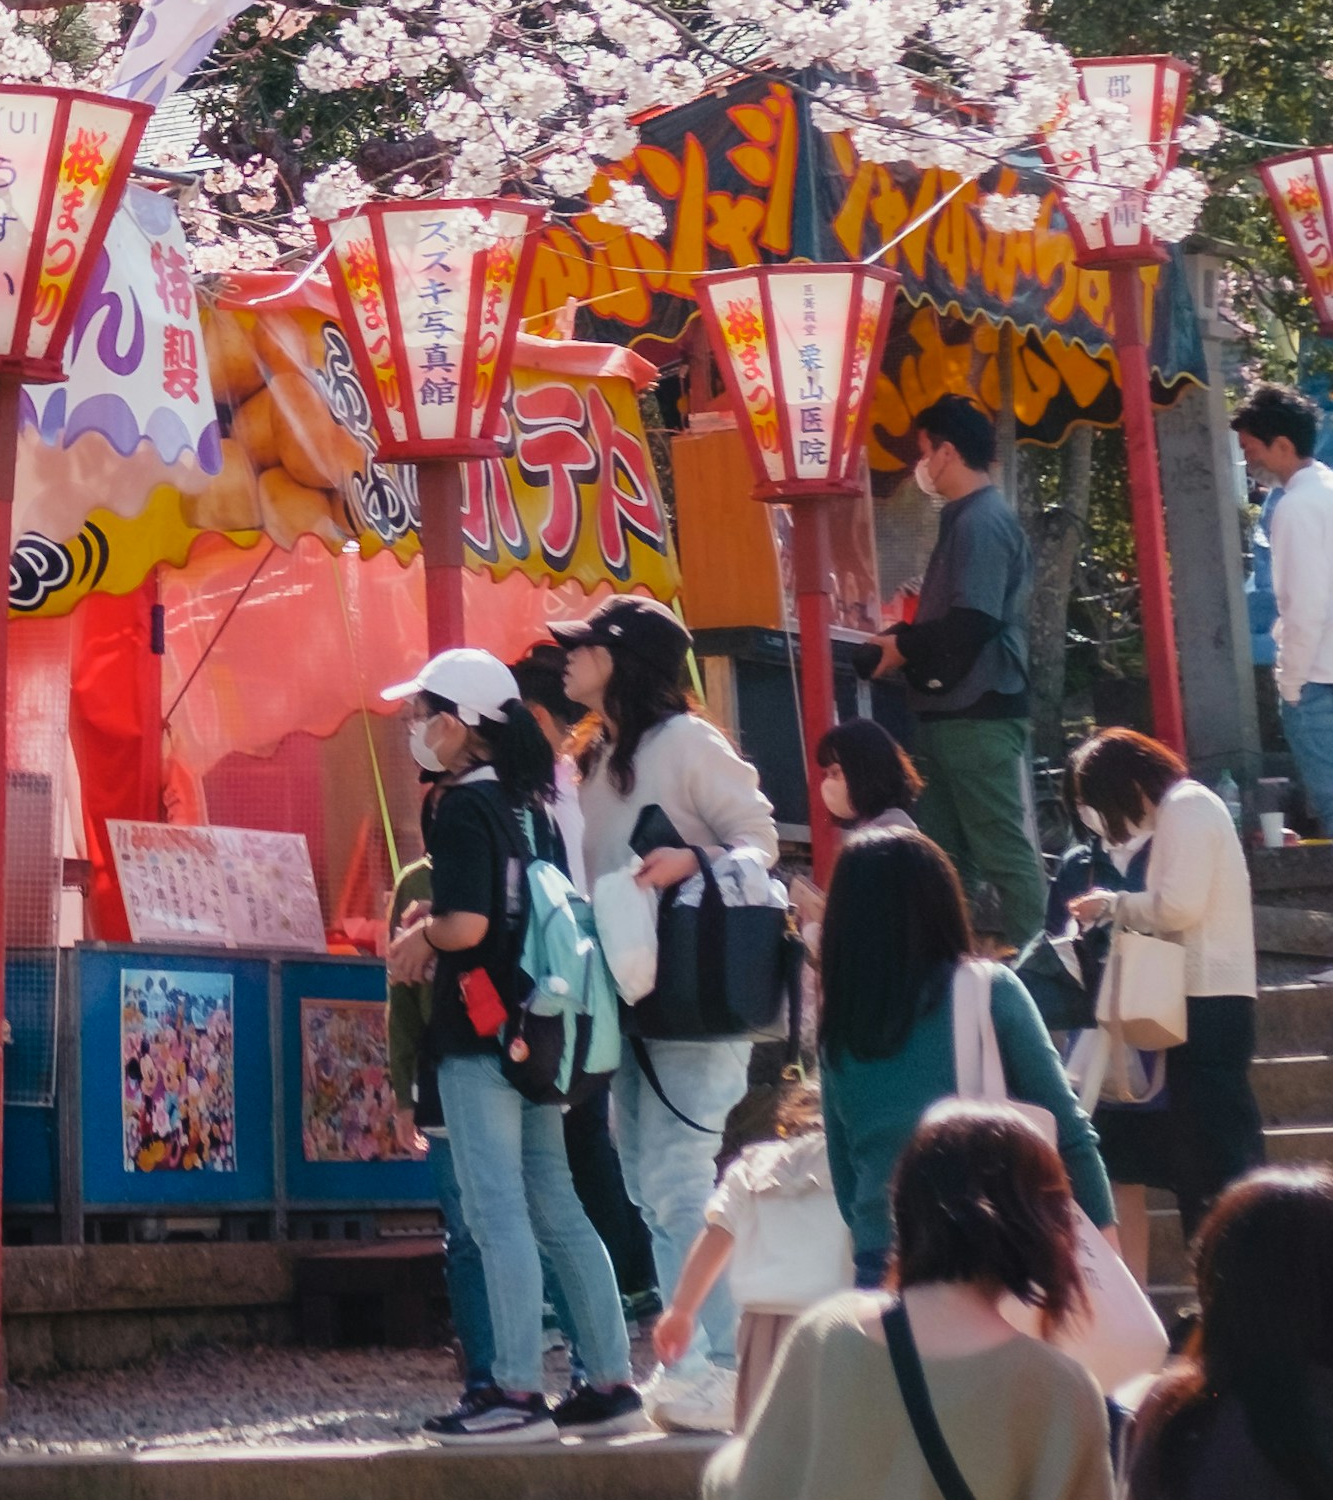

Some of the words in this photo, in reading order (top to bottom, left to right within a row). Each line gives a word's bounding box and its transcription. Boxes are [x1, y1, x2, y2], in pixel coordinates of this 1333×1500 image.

[34, 126, 109, 327] 桜まつり
[418, 219, 460, 407] スズキ写真館
[149, 240, 201, 406] 特製
[725, 296, 782, 455] 桜まつり
